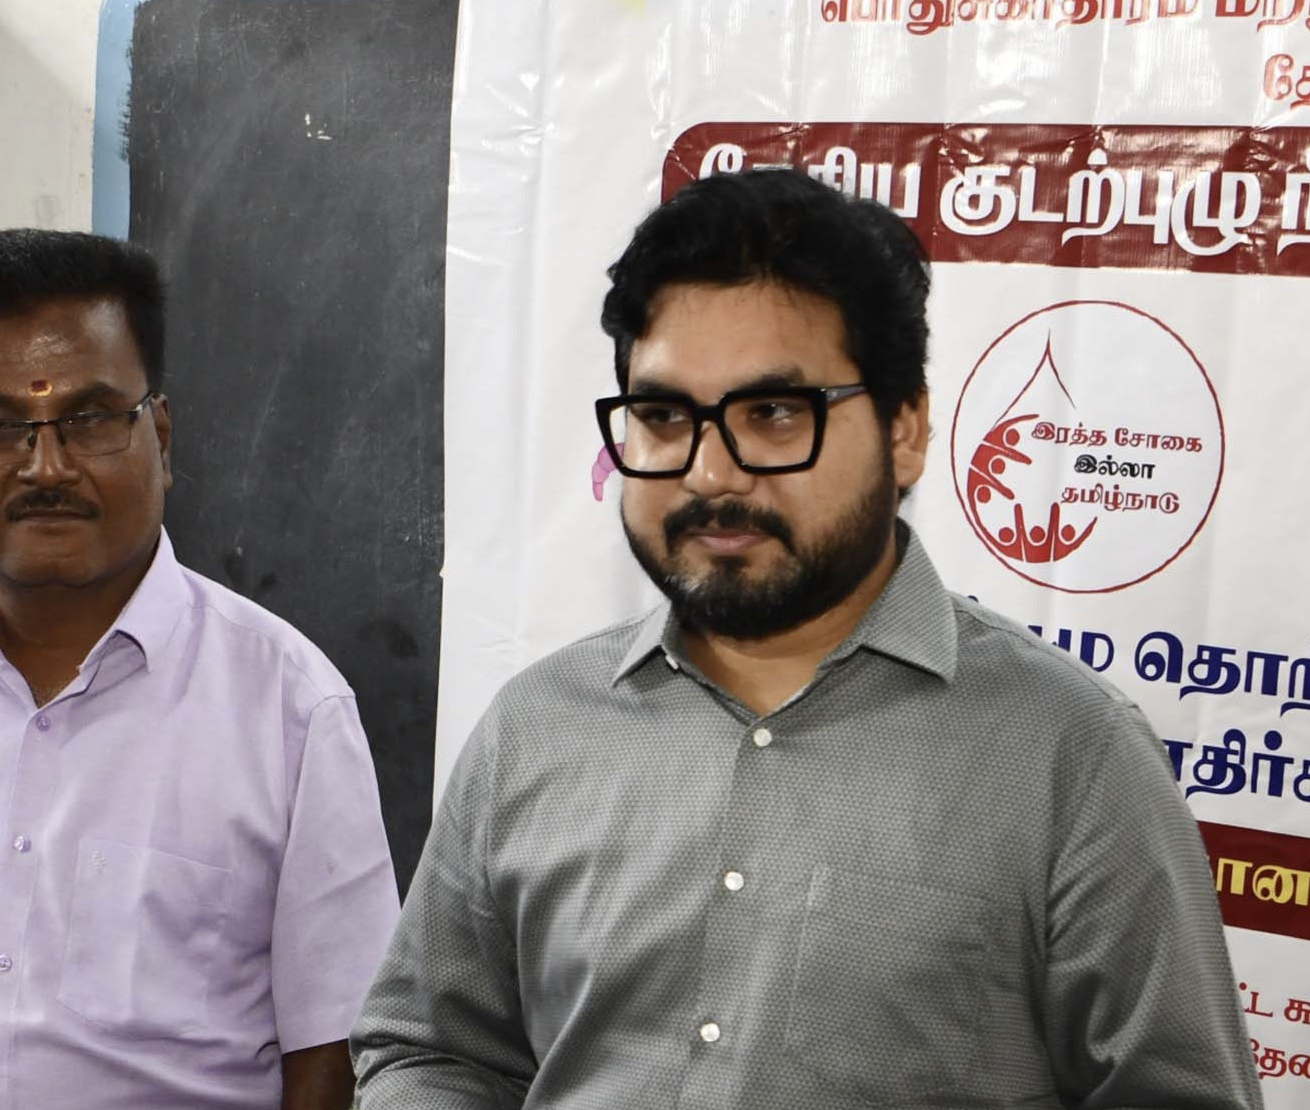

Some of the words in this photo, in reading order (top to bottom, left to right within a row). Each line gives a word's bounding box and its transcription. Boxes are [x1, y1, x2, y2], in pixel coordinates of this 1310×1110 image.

[939, 148, 1262, 256] குடற்புழு
[1030, 421, 1108, 447] இரத்த
[1113, 426, 1204, 453] சோகை
[1073, 453, 1156, 480] இல்லா
[1060, 482, 1181, 514] தமிழ்நாடு
